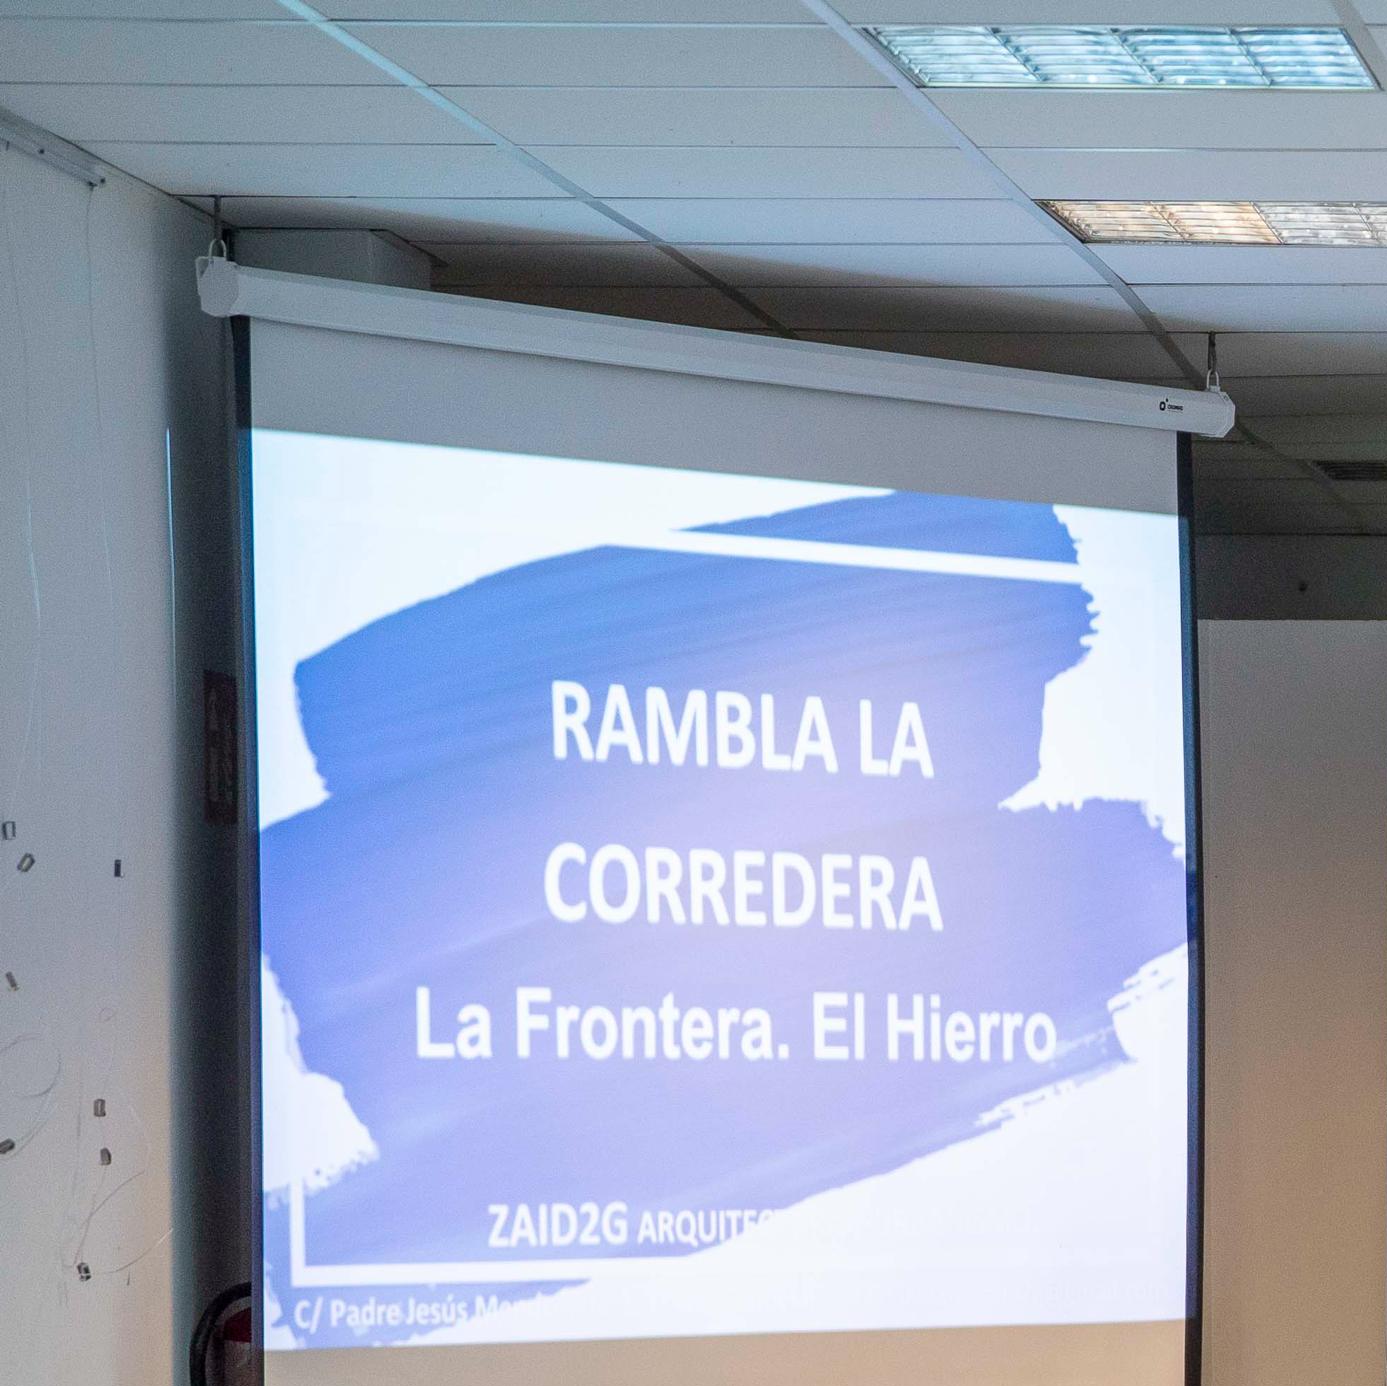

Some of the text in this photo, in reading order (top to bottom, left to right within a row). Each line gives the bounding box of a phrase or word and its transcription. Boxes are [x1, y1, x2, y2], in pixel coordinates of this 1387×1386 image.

[551, 680, 934, 779] RAMBLA LA
[544, 843, 943, 932] CORREDERA
[415, 986, 1057, 1063] La Frontera. El Hierro
[488, 1201, 629, 1248] ZAID2G
[330, 1296, 400, 1329] Padre
[402, 1292, 468, 1327] Jesús
